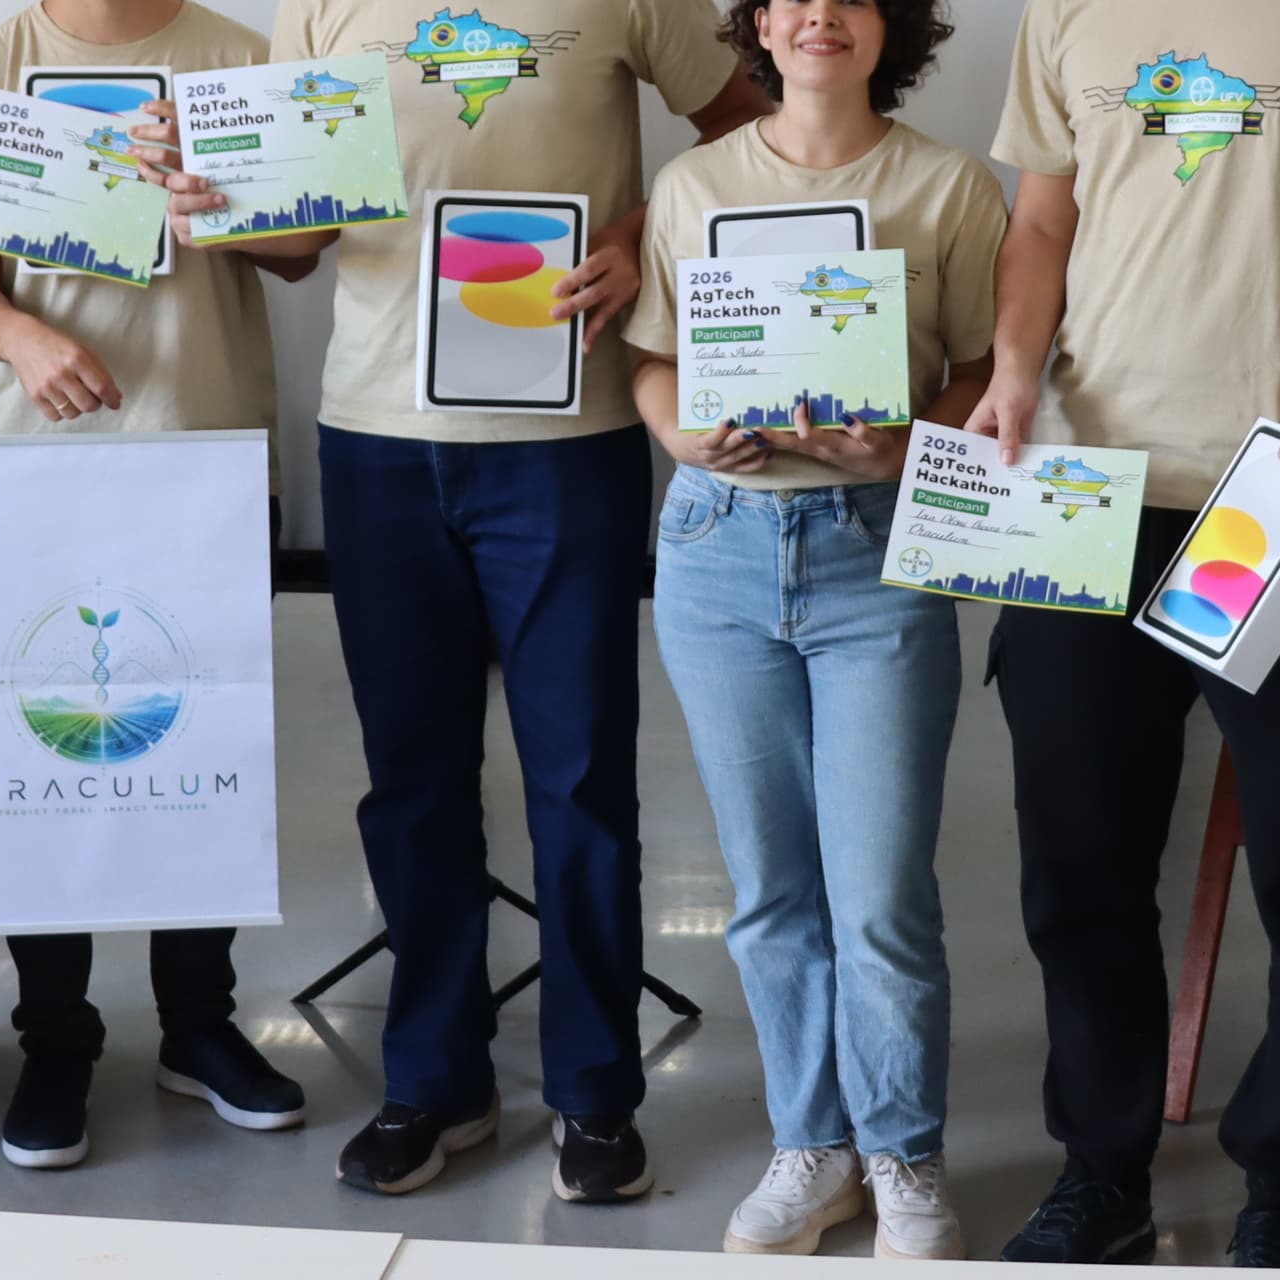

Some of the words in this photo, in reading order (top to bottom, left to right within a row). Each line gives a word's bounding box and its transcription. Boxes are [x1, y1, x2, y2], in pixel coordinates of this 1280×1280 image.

[497, 42, 518, 52] UFV
[186, 82, 226, 98] 2026
[1221, 92, 1243, 103] UFV
[188, 97, 248, 116] AgTech
[190, 111, 275, 131] Hackathon
[196, 136, 257, 152] Participant
[690, 271, 732, 285] 2026
[690, 287, 755, 303] AgTech
[690, 303, 781, 319] Hackathon
[695, 327, 761, 343] Participant
[922, 435, 967, 456] 2026
[919, 452, 987, 477] AgTech
[916, 469, 1011, 497] Hackathon
[916, 491, 986, 514] Participant
